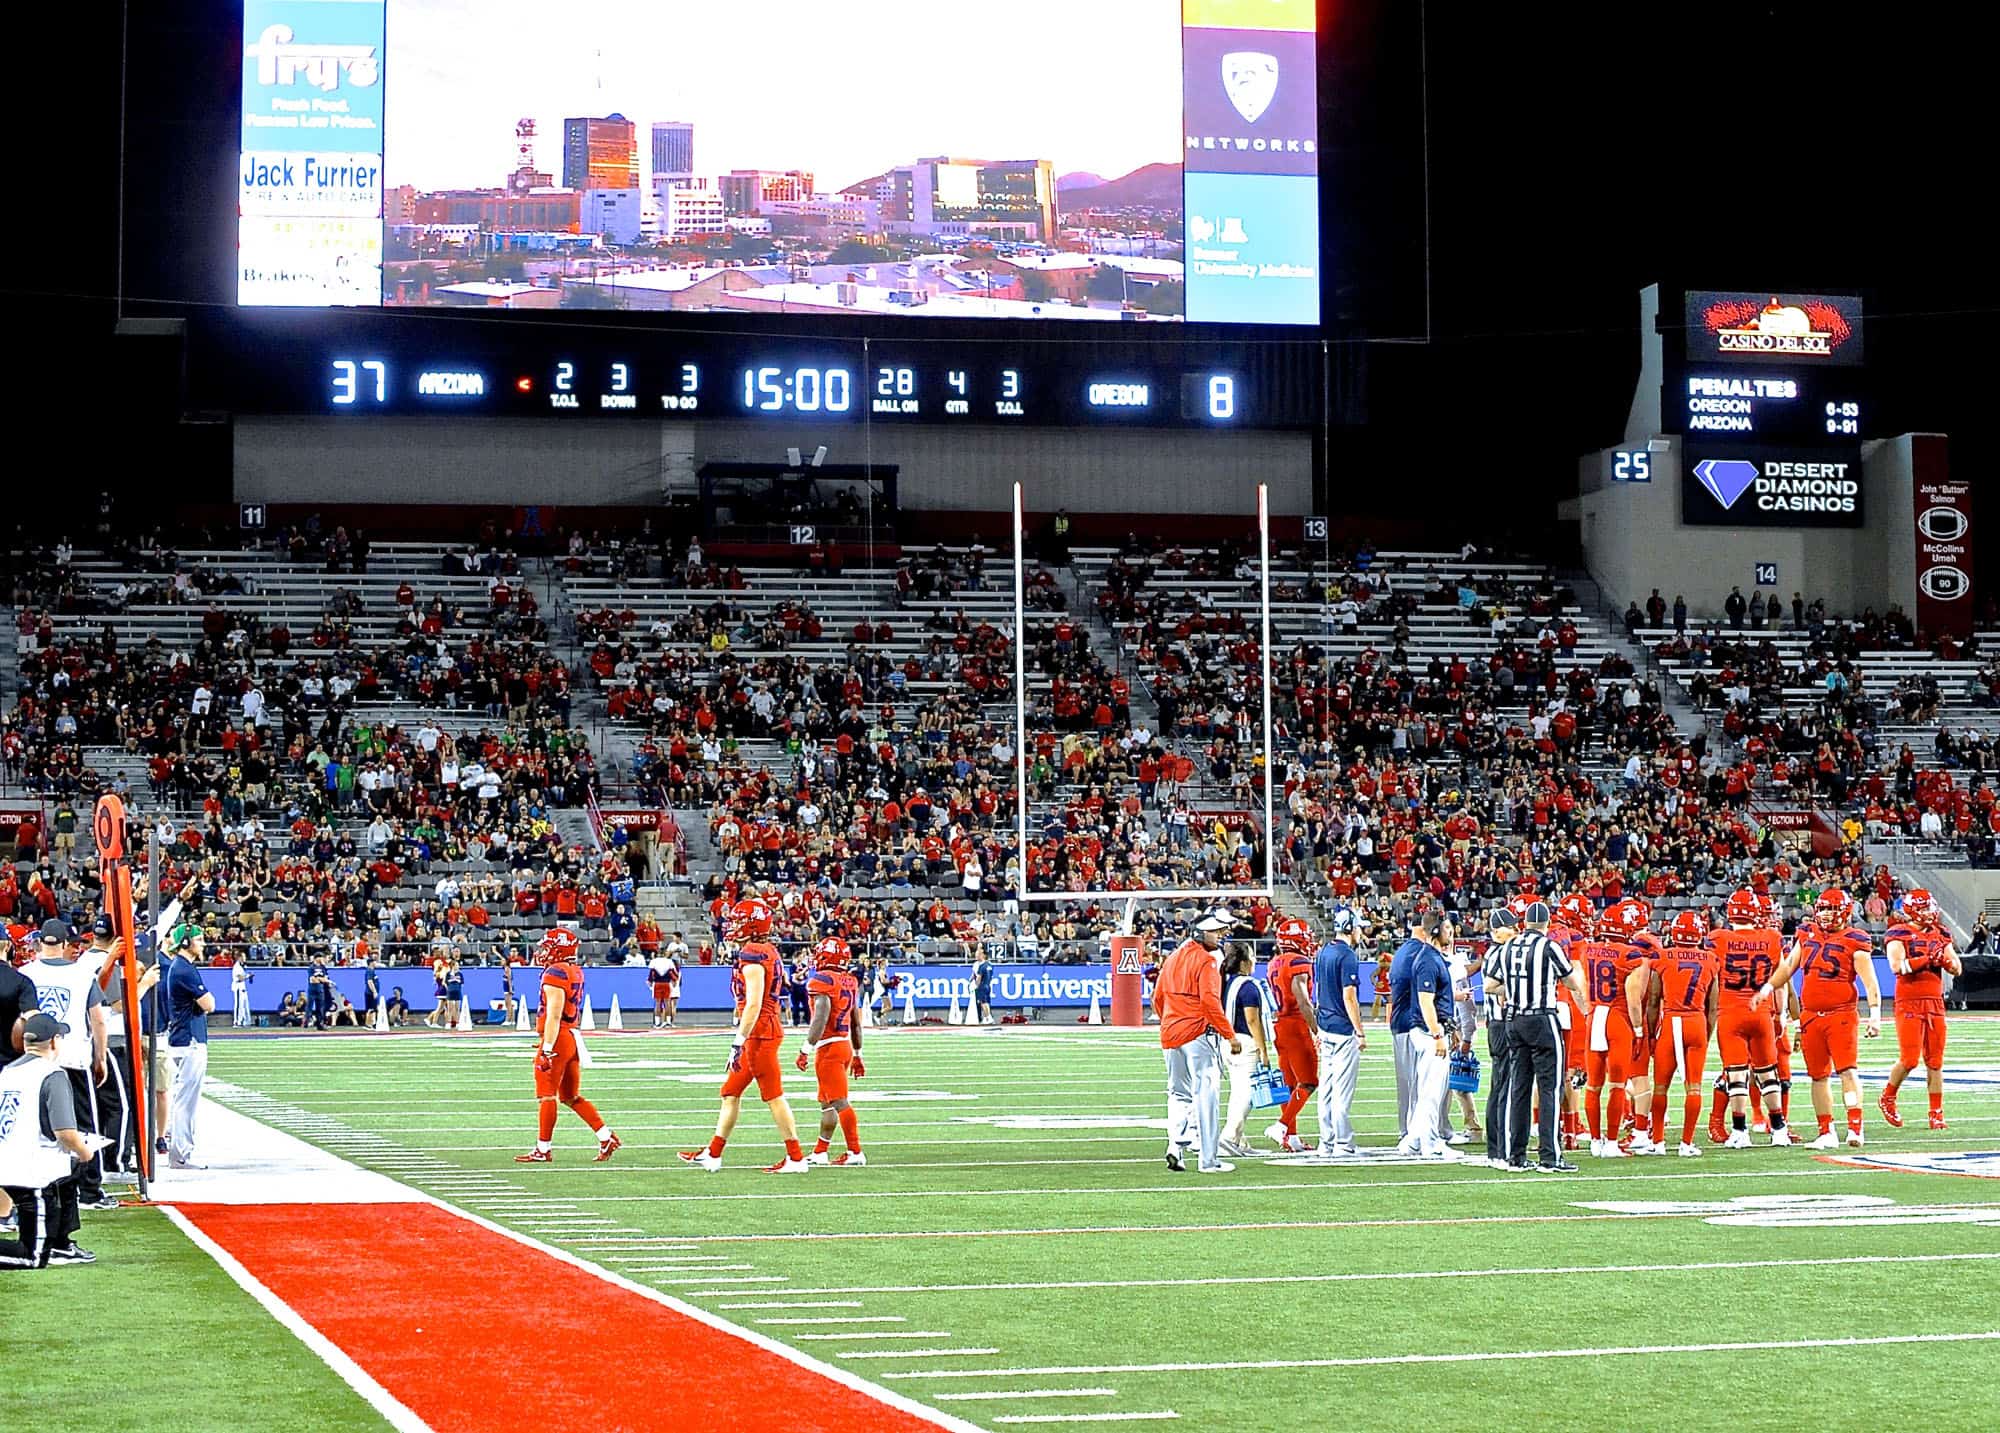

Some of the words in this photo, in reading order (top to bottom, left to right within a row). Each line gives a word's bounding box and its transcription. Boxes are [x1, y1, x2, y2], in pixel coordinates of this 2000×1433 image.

[1186, 136, 1316, 153] NETWORKS
[244, 157, 294, 187] Jack
[305, 158, 377, 188] Furrier
[1719, 334, 1773, 349] CASINO
[1776, 336, 1800, 350] DEL
[1803, 337, 1830, 350] SOL
[333, 360, 385, 404] 37
[418, 372, 483, 395] ARIZONA
[556, 362, 573, 389] 2
[611, 363, 627, 391] 3
[682, 365, 698, 392] 3
[878, 368, 913, 395] 28
[948, 370, 965, 395] 4
[1003, 371, 1018, 397] 3
[745, 367, 850, 411] 15:00
[1089, 383, 1149, 407] OREGON
[1209, 376, 1233, 418] 8
[1688, 378, 1797, 398] PENALTIES
[601, 395, 636, 408] DOWN
[661, 396, 678, 409] TO
[679, 396, 698, 409] GO
[873, 400, 901, 413] BALL
[901, 400, 919, 413] ON
[945, 400, 969, 414] QTR
[1689, 399, 1752, 413] OREGON
[1689, 416, 1753, 431] ARIZONA
[1615, 452, 1649, 479] 25
[1764, 462, 1848, 478] DESERT
[1755, 479, 1858, 495] DIAMOND
[1920, 484, 1937, 493] John
[1758, 495, 1856, 512] CASINOS
[244, 507, 262, 524] 11
[792, 527, 813, 544] 12
[1305, 520, 1325, 537] 13
[1923, 544, 1965, 553] McCollins
[1756, 566, 1776, 582] 14
[1938, 579, 1951, 588] 90
[989, 945, 1004, 959] 12
[1117, 948, 1141, 974] A
[1510, 945, 1530, 976] H
[1804, 940, 1844, 978] 75
[1588, 959, 1617, 1003] 18
[1725, 953, 1773, 992] 50
[894, 972, 998, 999] Bannr
[999, 971, 1112, 1000] Universi
[1678, 961, 1703, 1006] 7
